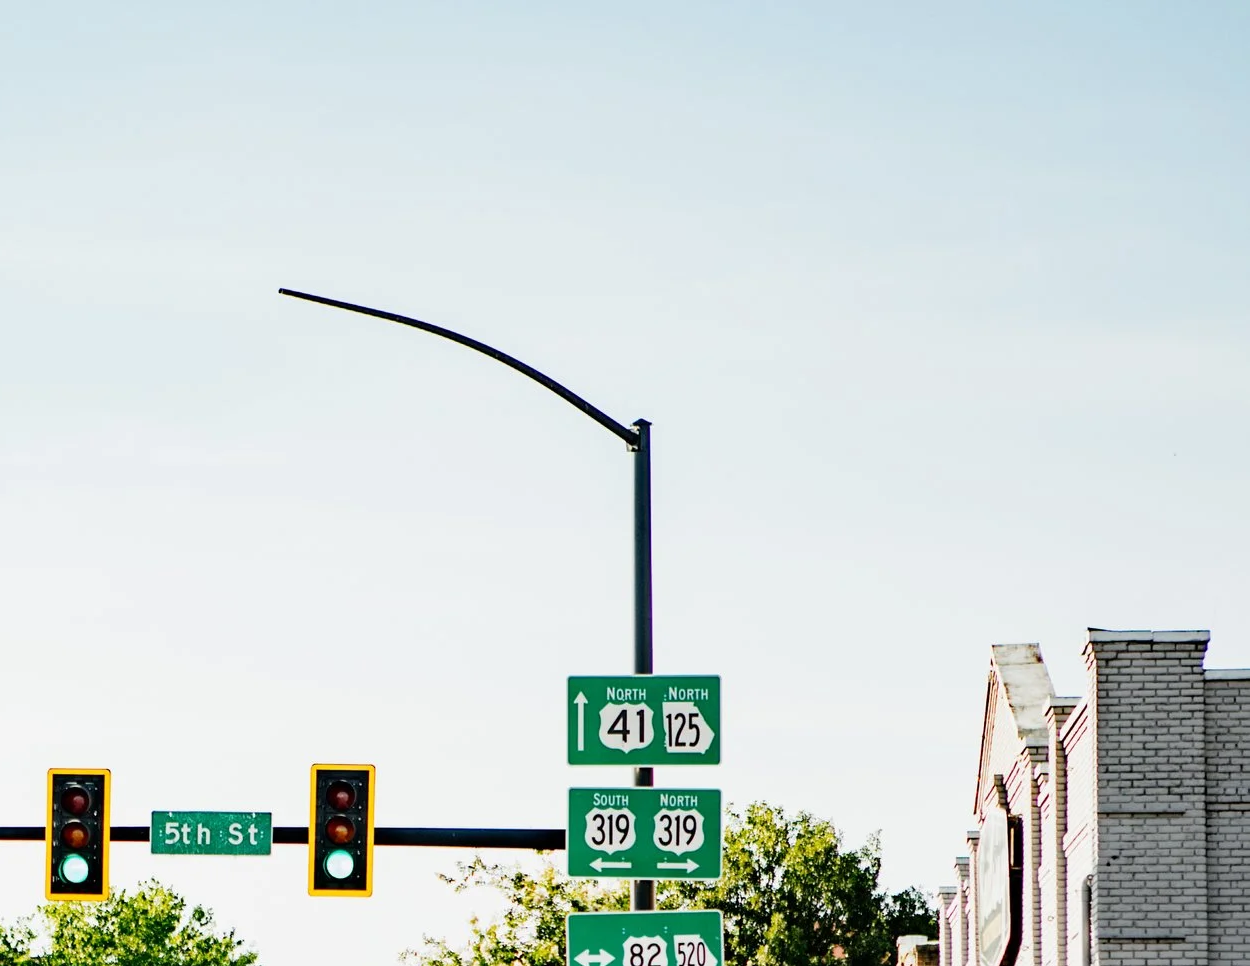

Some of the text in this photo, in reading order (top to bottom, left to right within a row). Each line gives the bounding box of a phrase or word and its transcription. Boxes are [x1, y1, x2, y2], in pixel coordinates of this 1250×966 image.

[606, 686, 647, 701] NORTH
[668, 686, 709, 701] NORTH
[607, 709, 645, 743] 41
[666, 713, 701, 747] 125
[593, 793, 629, 806] SOUTH
[660, 793, 698, 807] NORTH
[164, 822, 259, 845] 5th St
[591, 813, 630, 846] 319
[658, 814, 697, 847] 319
